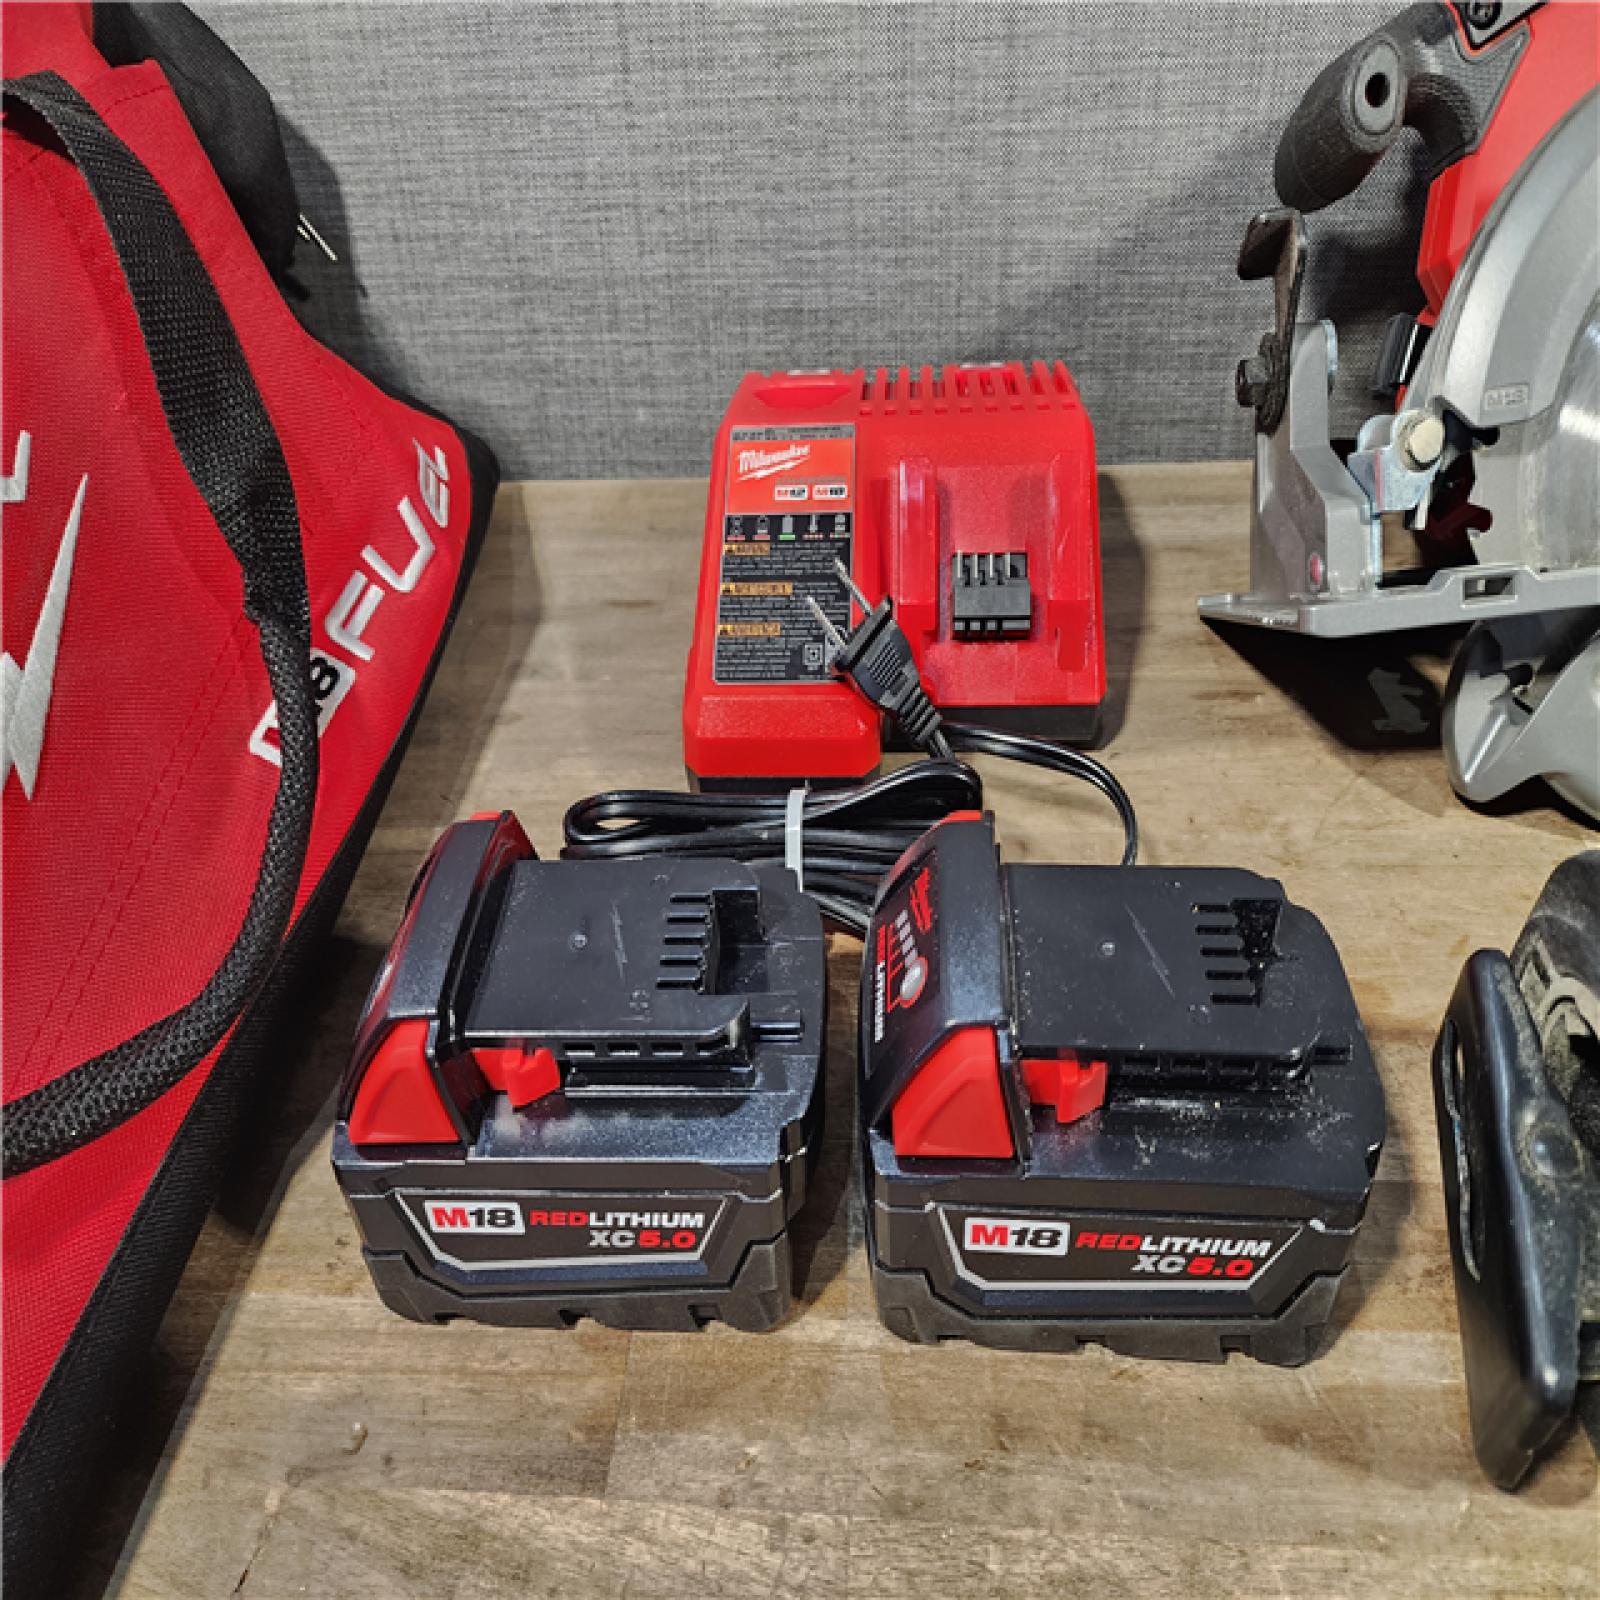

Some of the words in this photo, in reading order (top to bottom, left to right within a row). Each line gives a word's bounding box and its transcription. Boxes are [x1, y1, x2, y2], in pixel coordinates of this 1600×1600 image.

[325, 437, 449, 661] FUEL
[431, 1206, 517, 1229] M18
[529, 1209, 705, 1229] REDLITHIUM
[968, 1223, 1063, 1249] M18
[1075, 1231, 1273, 1258] REDLITHIUM
